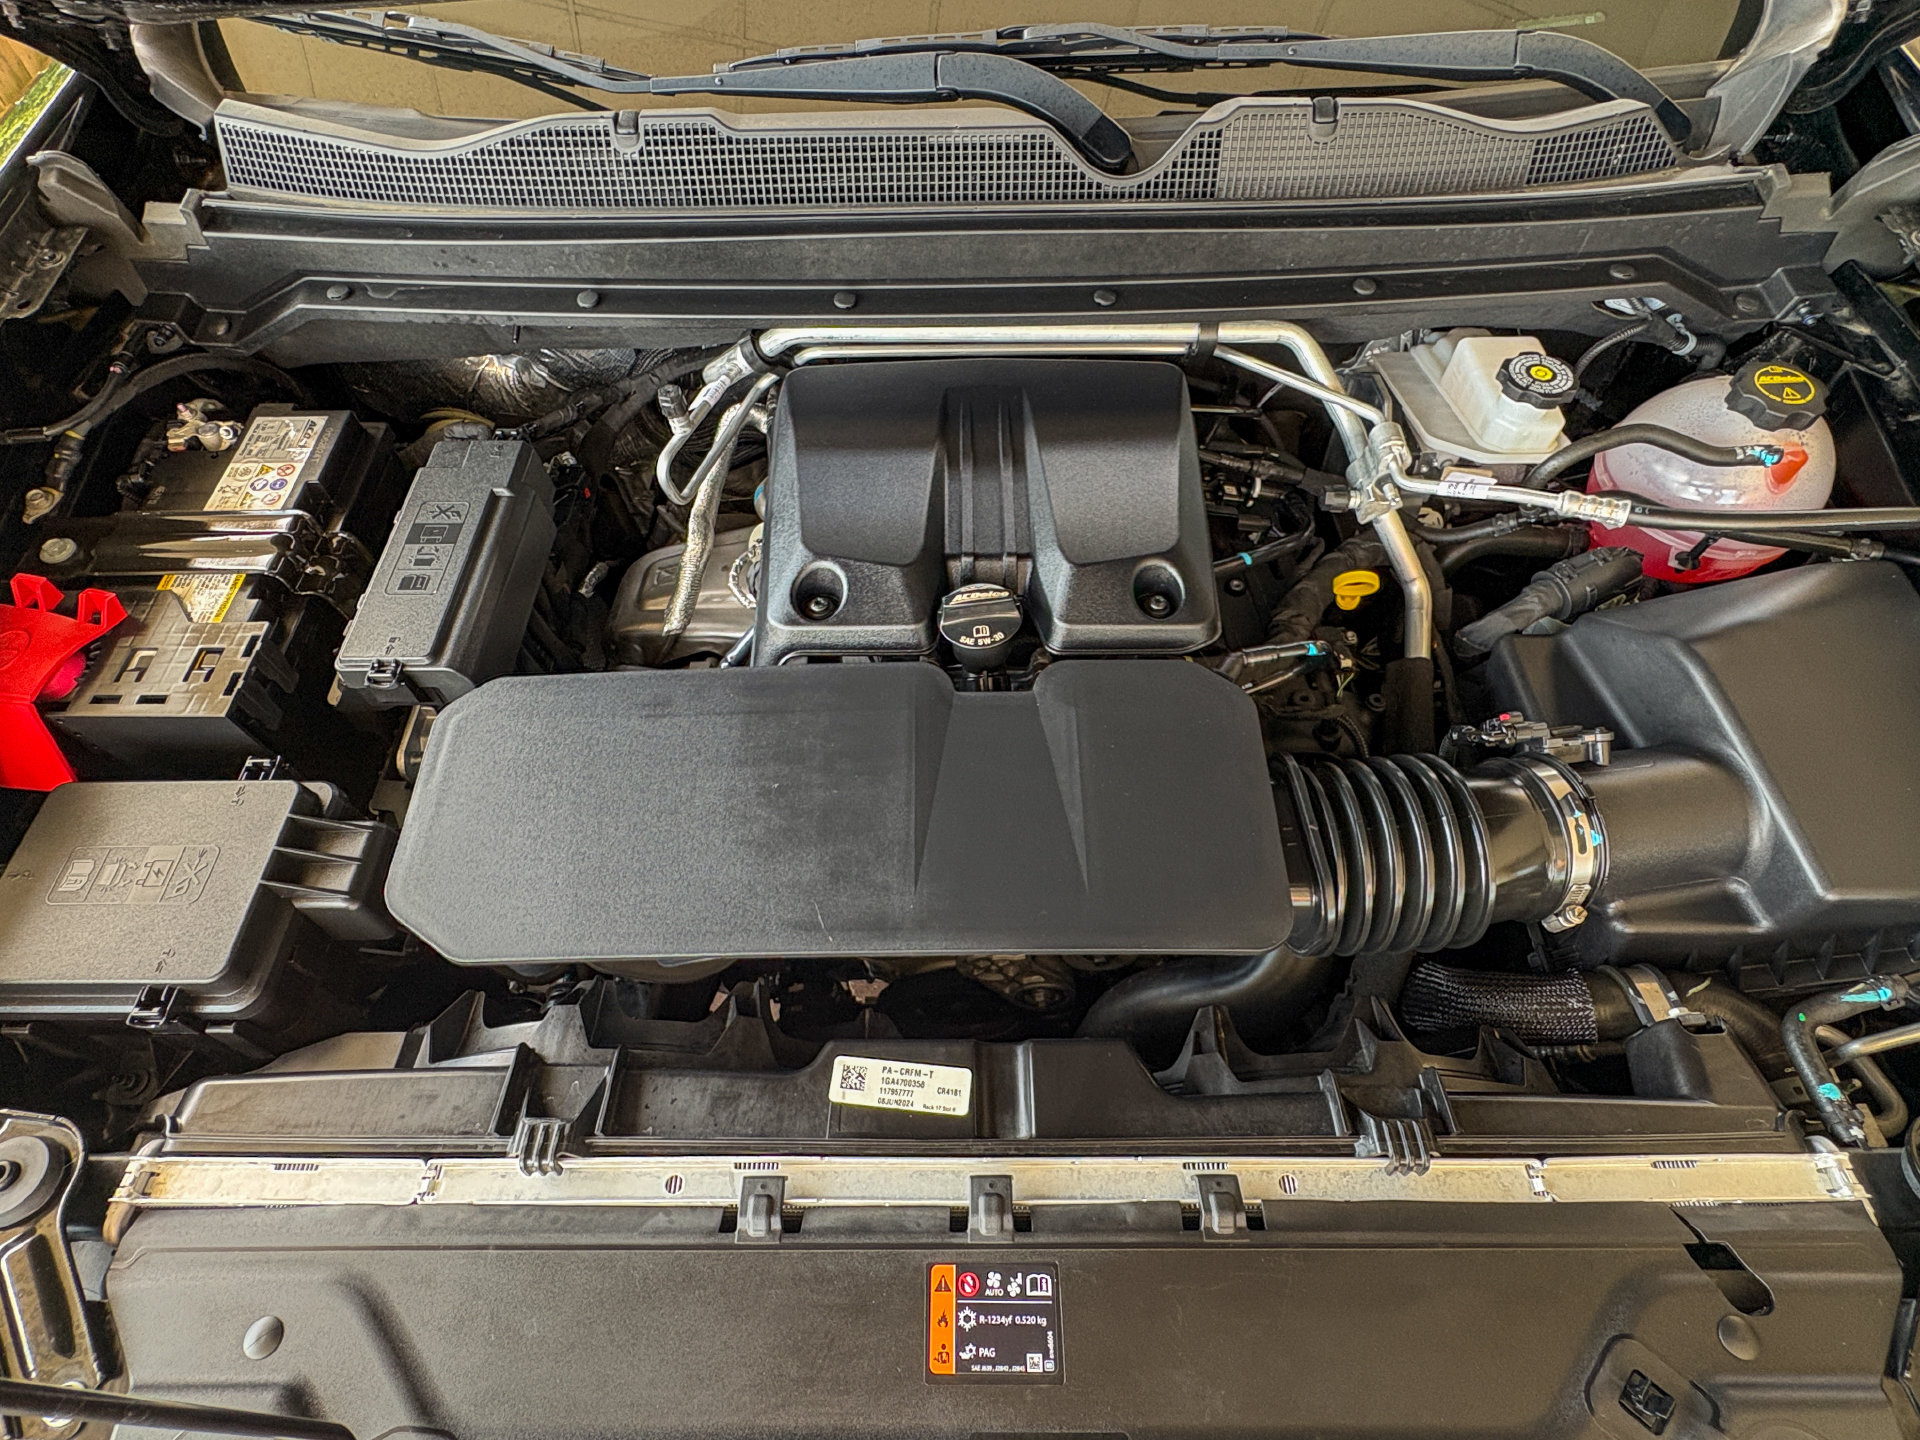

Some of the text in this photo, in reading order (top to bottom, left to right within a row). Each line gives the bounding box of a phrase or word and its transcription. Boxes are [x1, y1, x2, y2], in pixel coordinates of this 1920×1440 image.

[1759, 375, 1804, 384] ACDelco
[950, 591, 1010, 604] ACDelco
[960, 632, 1005, 645] SAE 5W-30
[985, 1288, 1004, 1297] AUTO
[979, 1315, 1047, 1327] R-1234yf 0.520 kg
[979, 1347, 995, 1357] PAG
